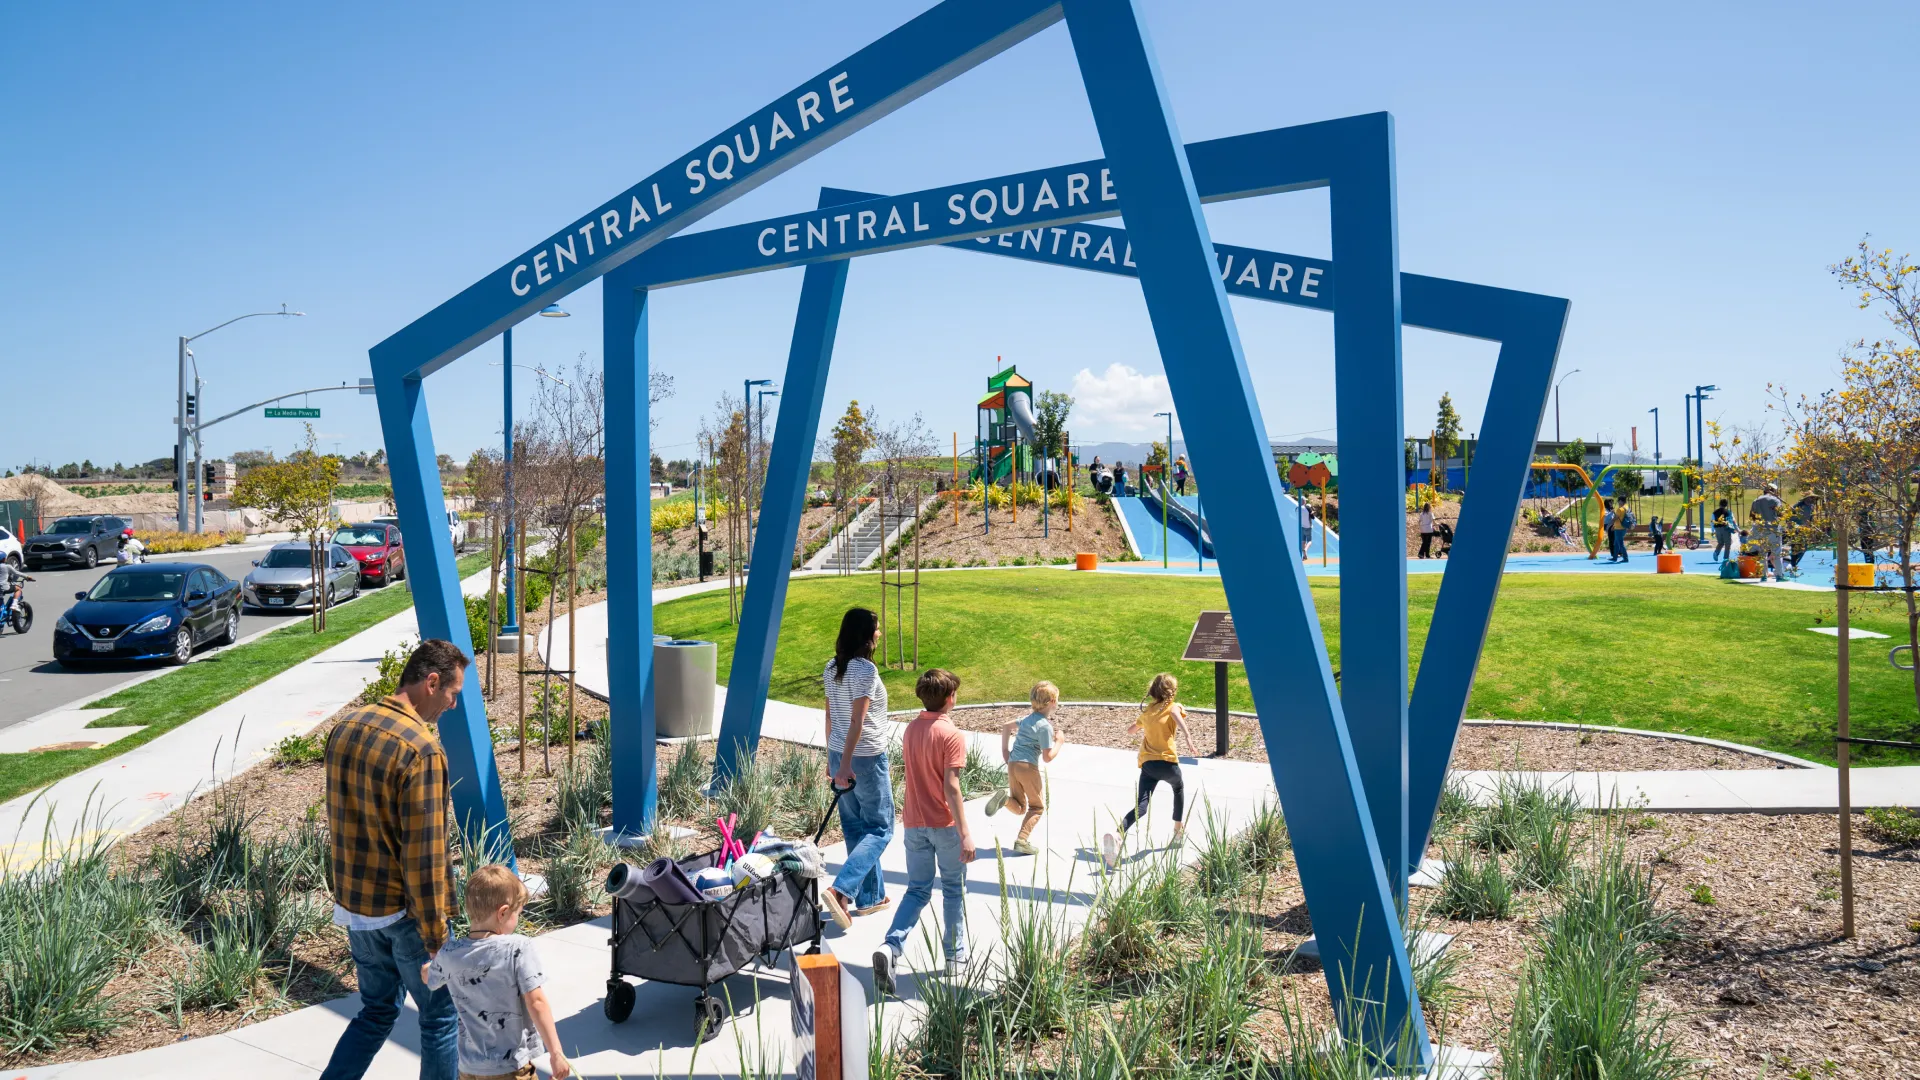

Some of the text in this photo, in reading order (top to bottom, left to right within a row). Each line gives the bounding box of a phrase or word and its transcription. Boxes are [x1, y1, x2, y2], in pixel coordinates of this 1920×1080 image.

[511, 71, 855, 297] CENTRAL SQUARE
[757, 168, 1117, 257] CENTRAL SQUARE
